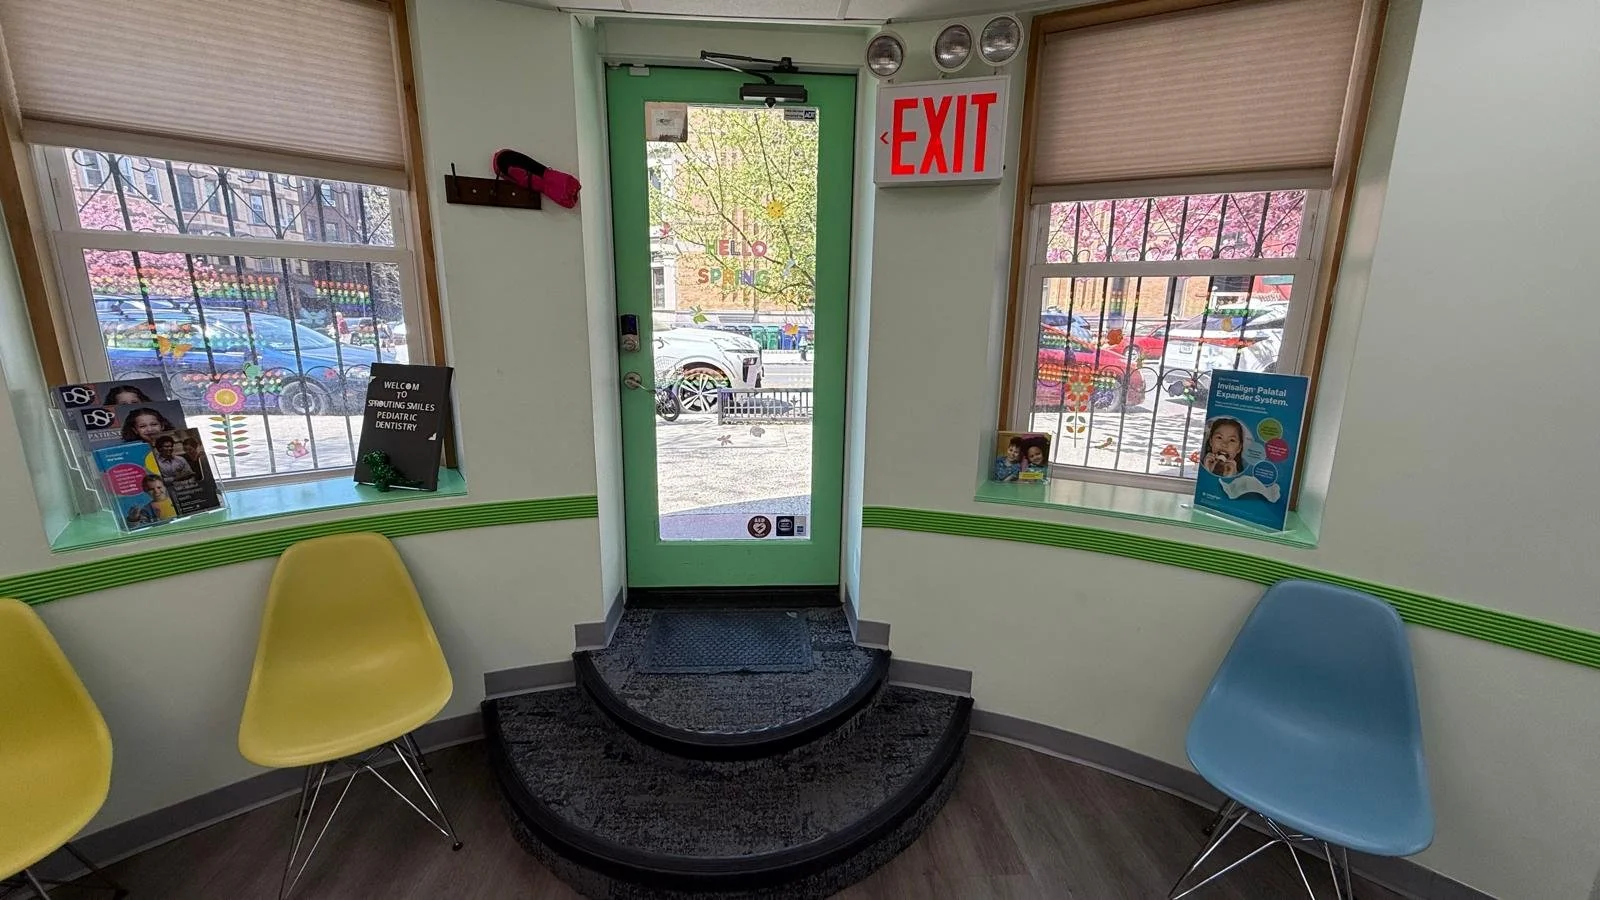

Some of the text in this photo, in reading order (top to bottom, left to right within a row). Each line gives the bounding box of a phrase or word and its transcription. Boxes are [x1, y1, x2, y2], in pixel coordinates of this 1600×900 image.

[891, 92, 998, 176] EXIT
[705, 239, 767, 257] HELLO
[697, 267, 769, 289] SPRING
[384, 381, 420, 391] WELCOM
[1217, 382, 1287, 397] Invisalign Palatal
[396, 390, 408, 399] TO
[1216, 389, 1289, 407] Expander System.
[367, 399, 436, 412] SPROUTING SMILES
[376, 411, 418, 422] PEDIATRIC
[375, 421, 418, 431] DENTISTRY
